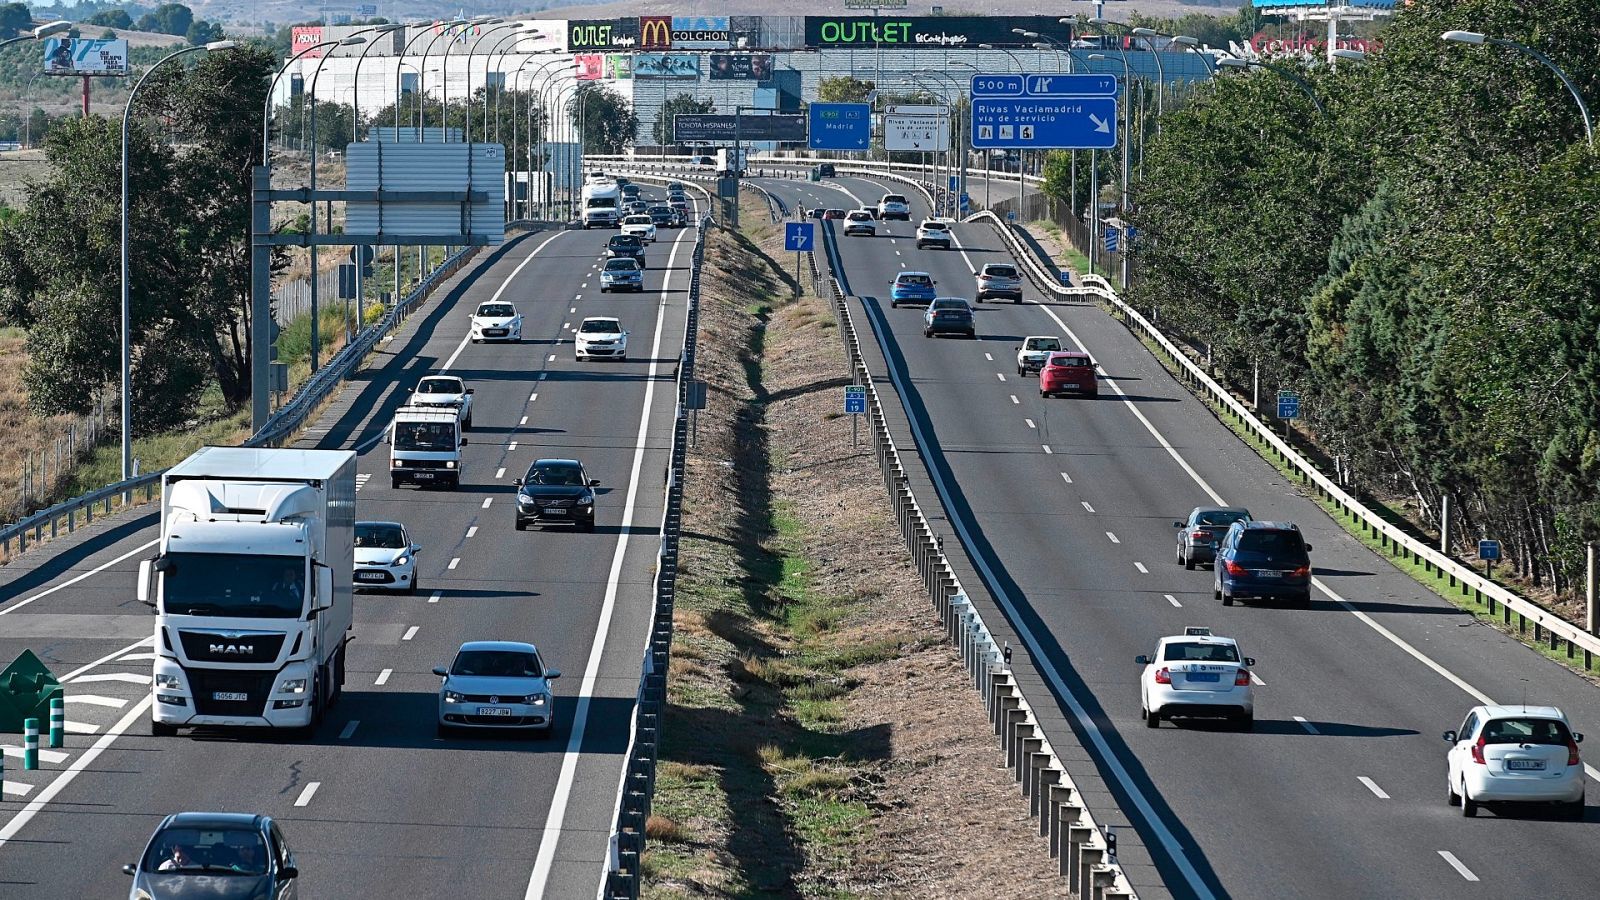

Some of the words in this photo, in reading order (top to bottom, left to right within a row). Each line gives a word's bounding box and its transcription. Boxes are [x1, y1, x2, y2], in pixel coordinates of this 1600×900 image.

[572, 26, 612, 46] OUTLET
[672, 31, 728, 40] COLCHON
[821, 22, 912, 43] OUTLET
[978, 81, 1004, 89] 500
[978, 105, 1008, 113] Rivas
[1014, 105, 1082, 113] Vaciamadrid
[209, 644, 254, 655] MAN
